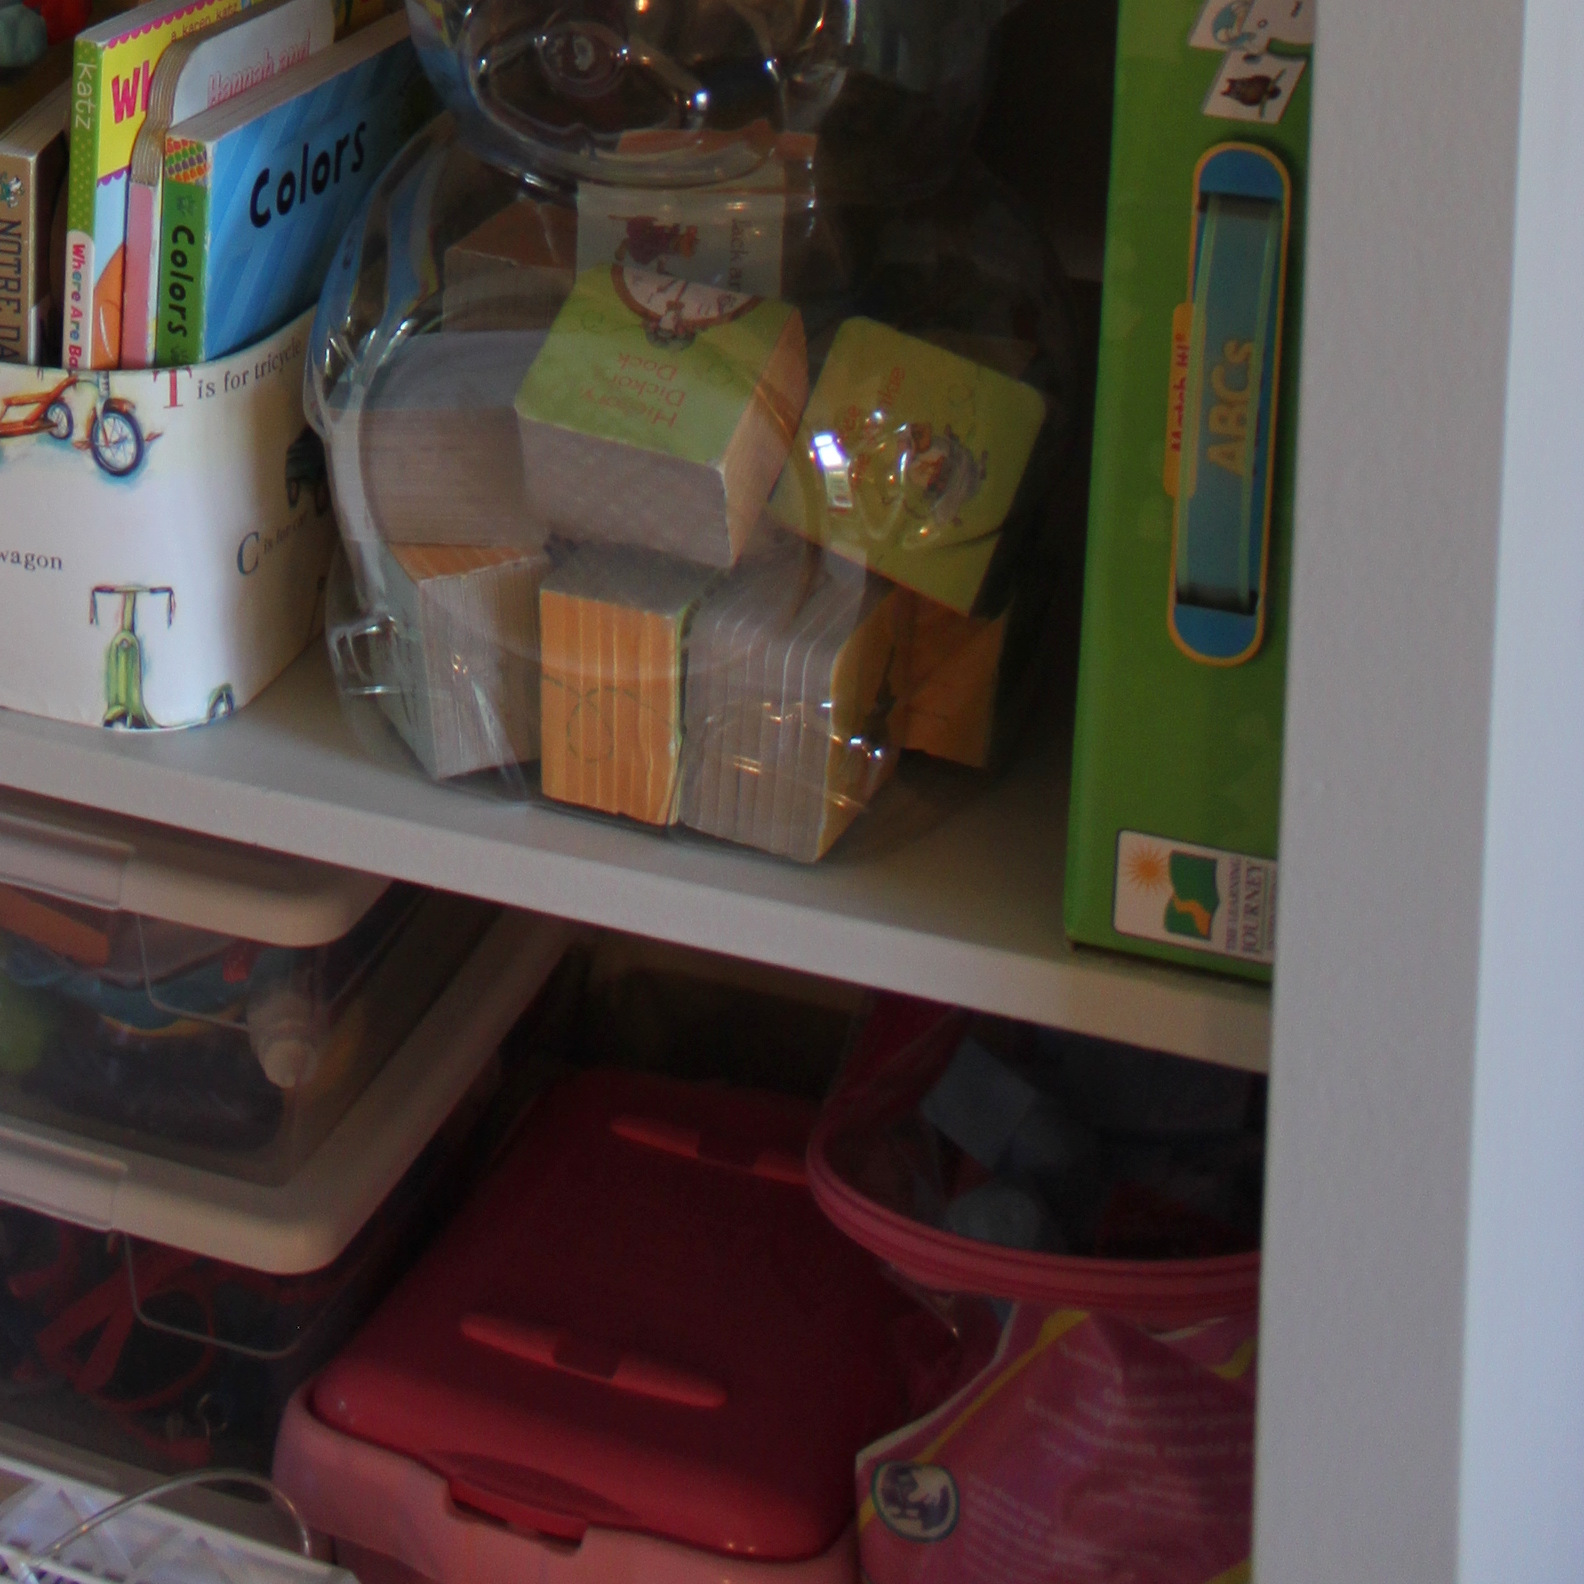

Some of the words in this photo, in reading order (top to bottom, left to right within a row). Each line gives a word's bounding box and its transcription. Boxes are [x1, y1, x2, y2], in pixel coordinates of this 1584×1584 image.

[182, 14, 211, 38] karen
[76, 63, 97, 130] katz
[208, 50, 274, 107] Hannah
[249, 122, 367, 230] Colors
[71, 243, 86, 303] Where
[168, 225, 195, 338] Colors
[69, 307, 83, 342] Are
[153, 368, 192, 409] T
[197, 380, 215, 399] is
[224, 370, 249, 393] for
[255, 337, 303, 381] tricycle
[1206, 338, 1254, 478] ABCs
